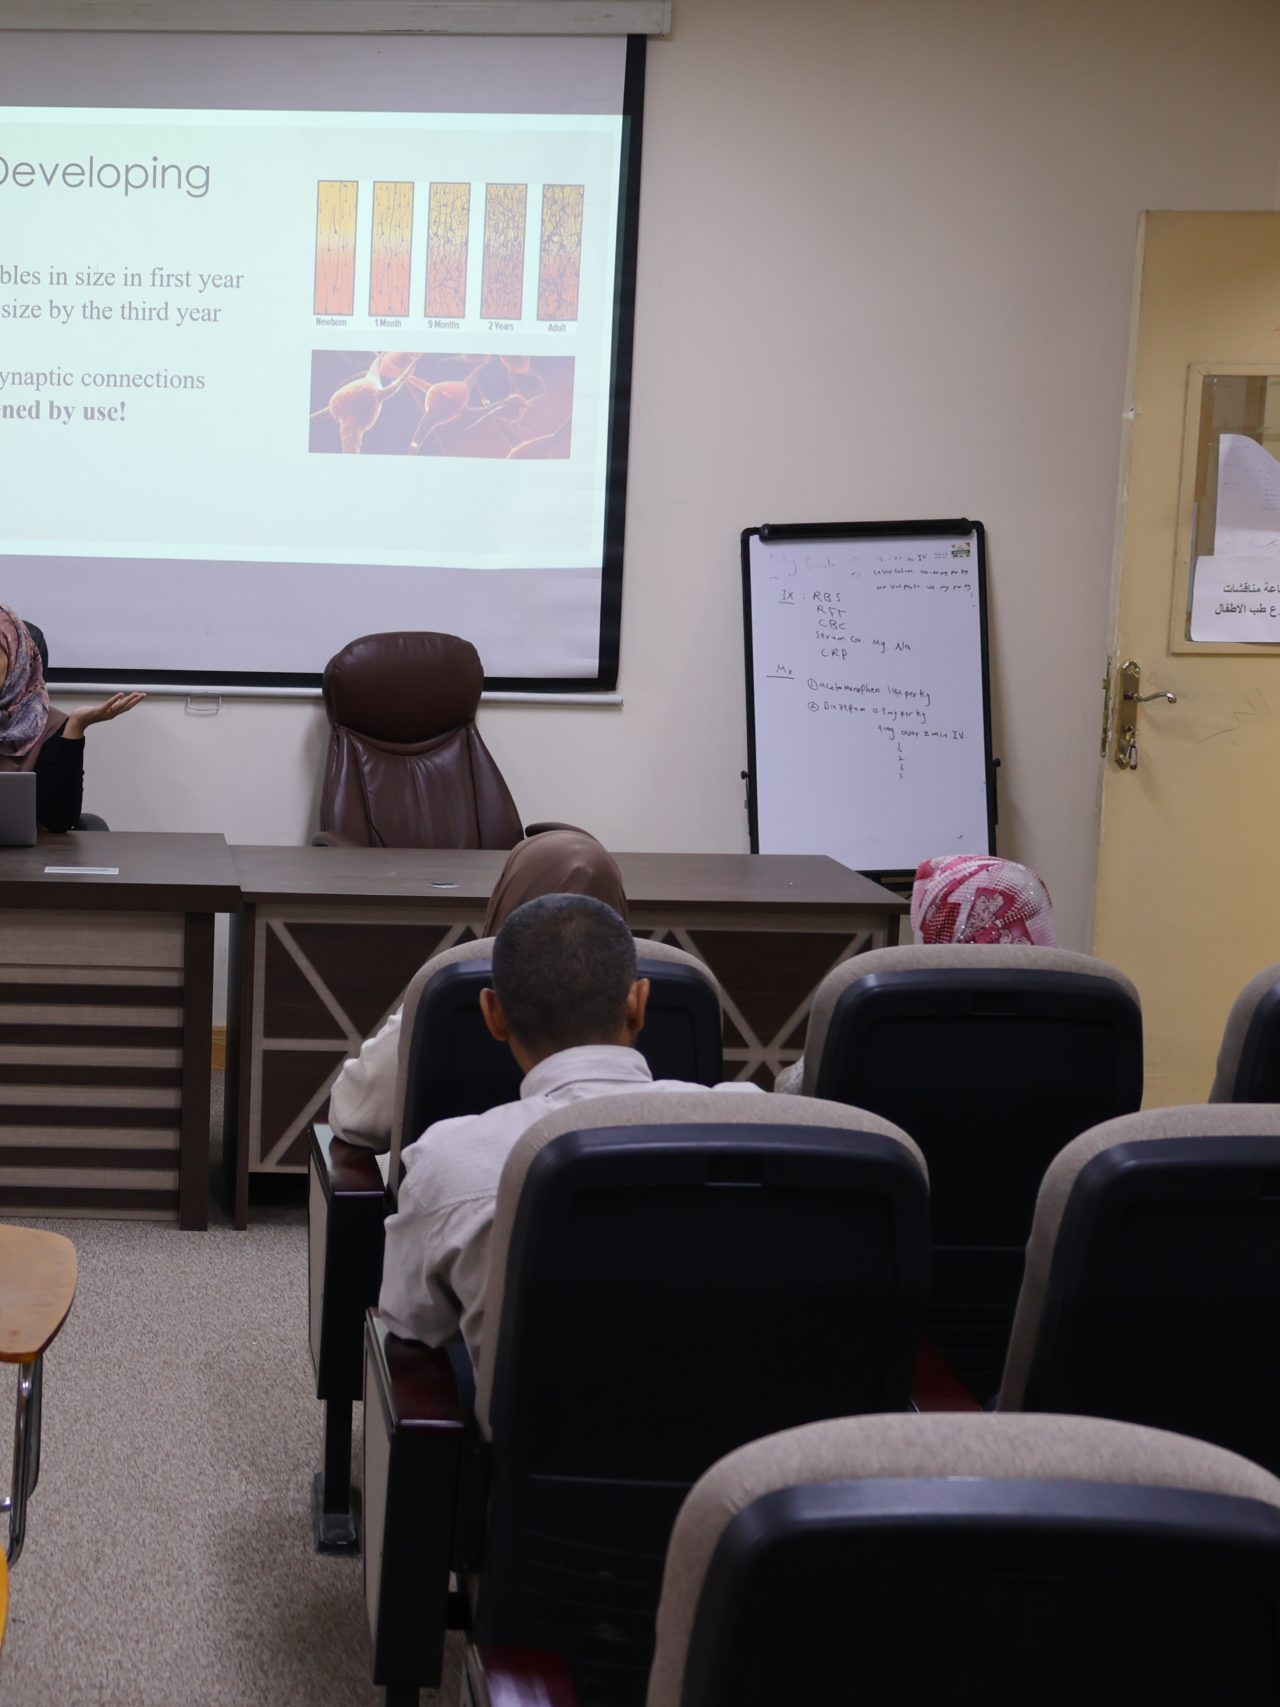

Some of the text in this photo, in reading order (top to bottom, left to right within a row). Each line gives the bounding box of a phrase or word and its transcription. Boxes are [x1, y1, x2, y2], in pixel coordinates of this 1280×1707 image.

[48, 266, 68, 286] in
[75, 266, 116, 287] size
[122, 266, 143, 288] in
[150, 267, 193, 288] first
[198, 271, 245, 294] year
[1, 299, 42, 319] size
[48, 299, 75, 324] by
[82, 300, 114, 320] the
[120, 300, 170, 322] third
[176, 305, 222, 326] year
[316, 317, 348, 327] Newborn
[380, 318, 402, 328] Month
[434, 320, 460, 330] Months
[488, 322, 514, 332] 2 Years
[548, 323, 567, 333] Adult
[80, 368, 206, 390] connections
[48, 400, 76, 425] by
[82, 400, 126, 422] use!
[1223, 582, 1280, 593] اعة مناقشات
[1214, 602, 1246, 616] الاطفال
[1249, 603, 1266, 616] طب
